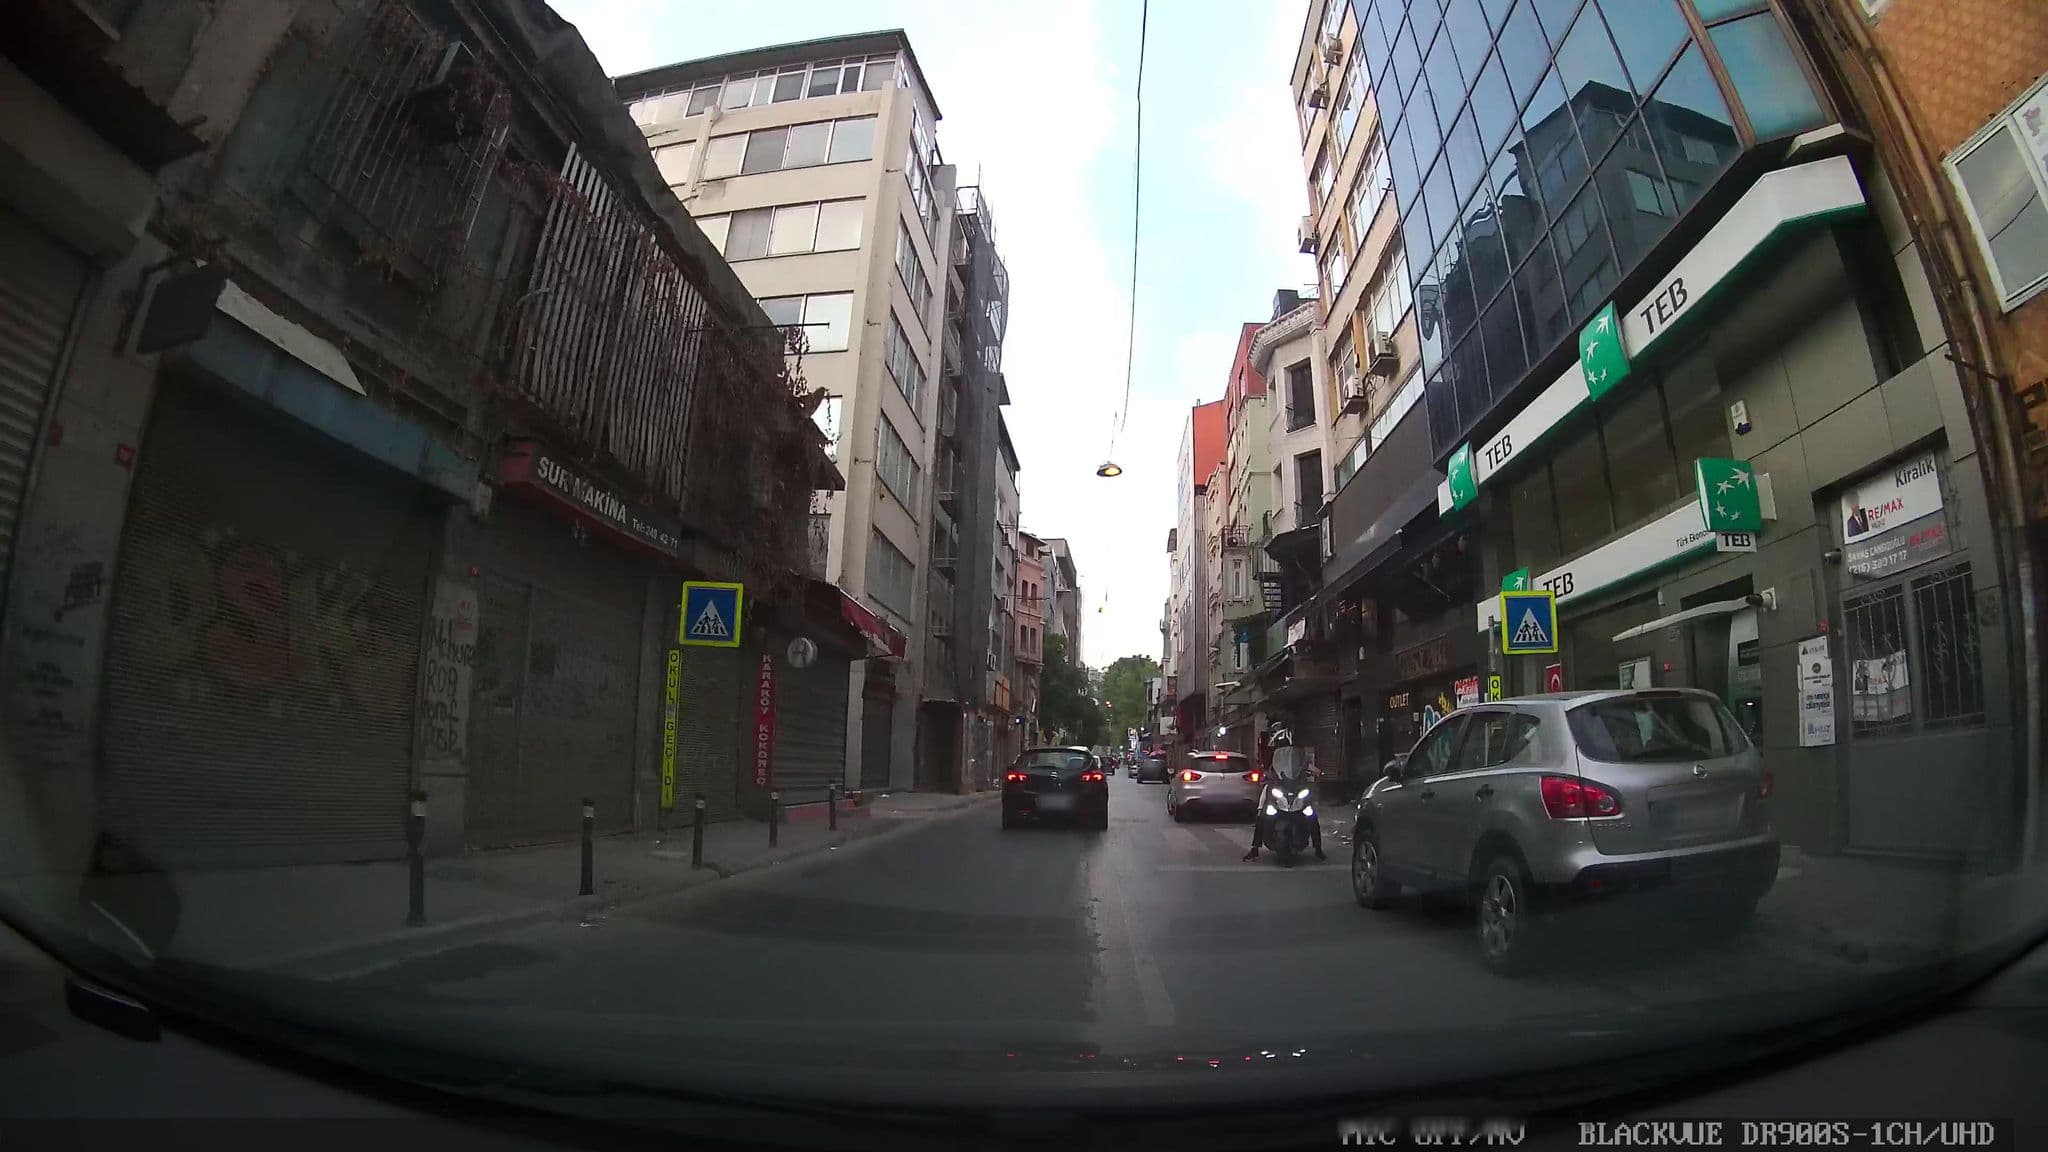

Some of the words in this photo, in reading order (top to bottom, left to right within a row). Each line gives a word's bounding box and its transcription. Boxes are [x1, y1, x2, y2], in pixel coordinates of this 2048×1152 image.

[1640, 278, 1687, 334] TEB
[1486, 435, 1512, 470] TEB
[1895, 460, 1935, 488] Kiralık
[1868, 497, 1904, 521] RE/MAX
[1721, 533, 1751, 547] TEB
[1543, 573, 1574, 599] TEB
[668, 653, 678, 704] OKUL
[1390, 692, 1410, 708] OUTLET
